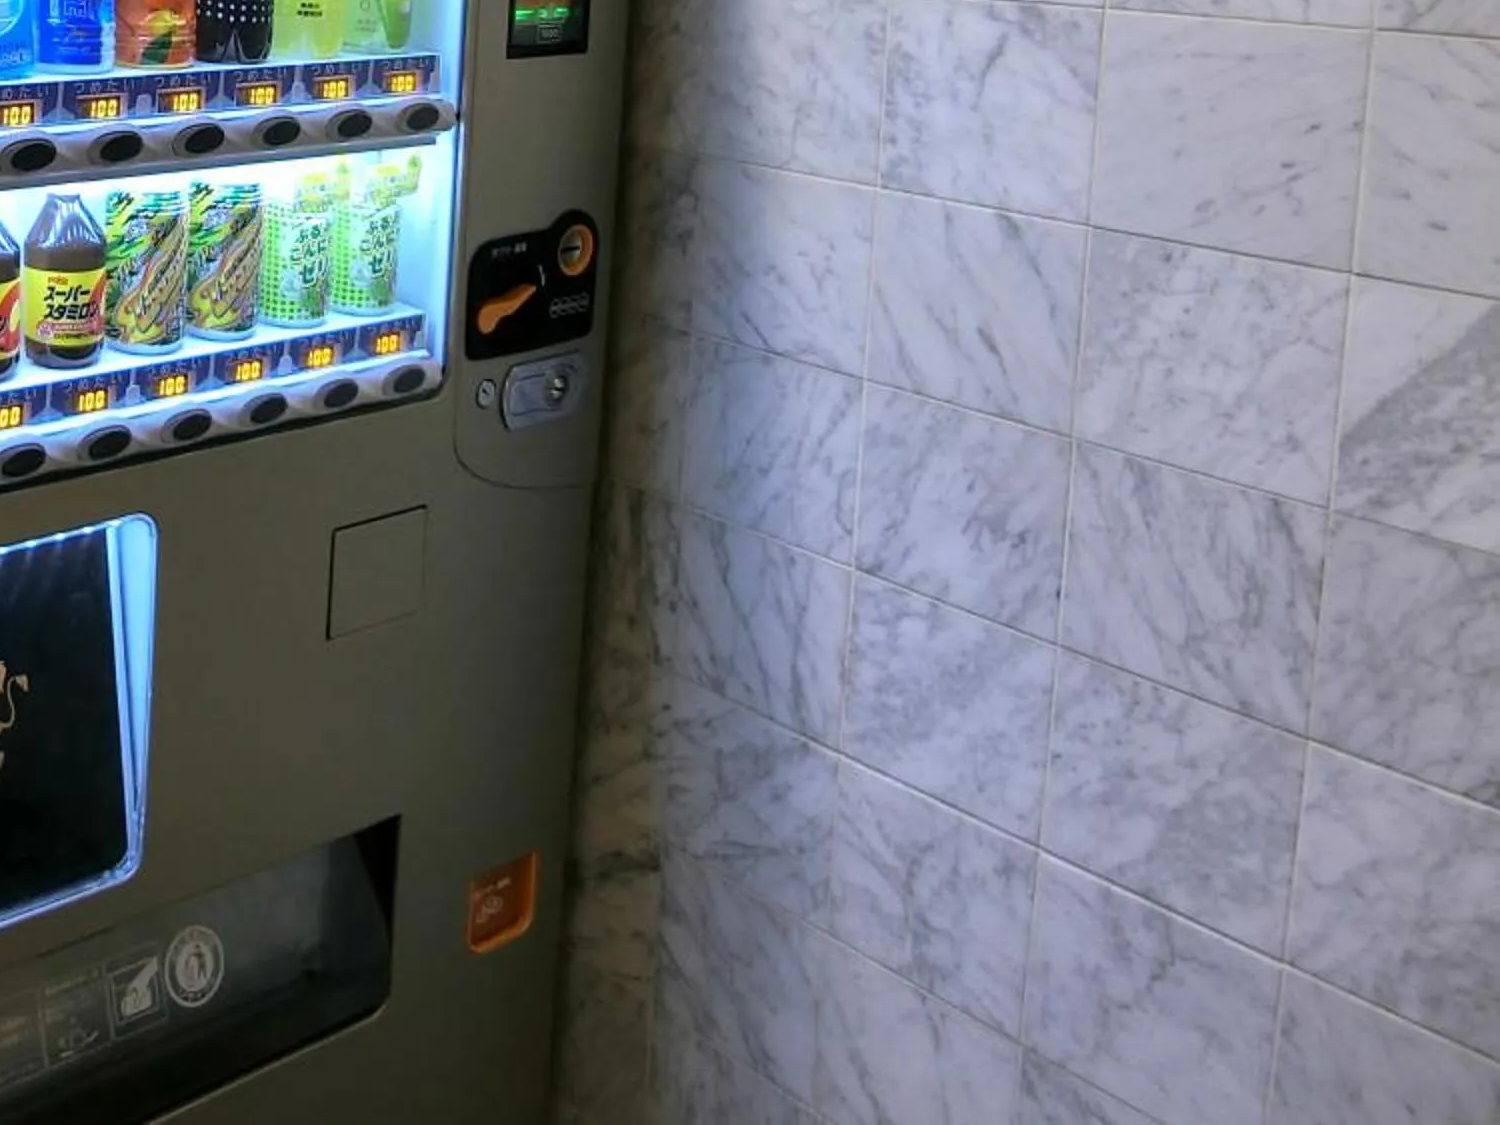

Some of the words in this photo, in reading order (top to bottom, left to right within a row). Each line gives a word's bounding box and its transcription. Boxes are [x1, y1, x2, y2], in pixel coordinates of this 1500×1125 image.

[323, 80, 346, 99] 100
[390, 75, 414, 93] 100
[173, 92, 198, 112] 100
[250, 87, 274, 106] 100
[3, 106, 31, 126] 100
[90, 99, 117, 118] 100
[44, 285, 91, 302] スーパー
[44, 302, 100, 320] スタミロン
[376, 334, 399, 354] 100
[308, 348, 332, 367] 100
[236, 361, 260, 380] 100
[159, 376, 185, 396] 100
[79, 390, 106, 411] 100
